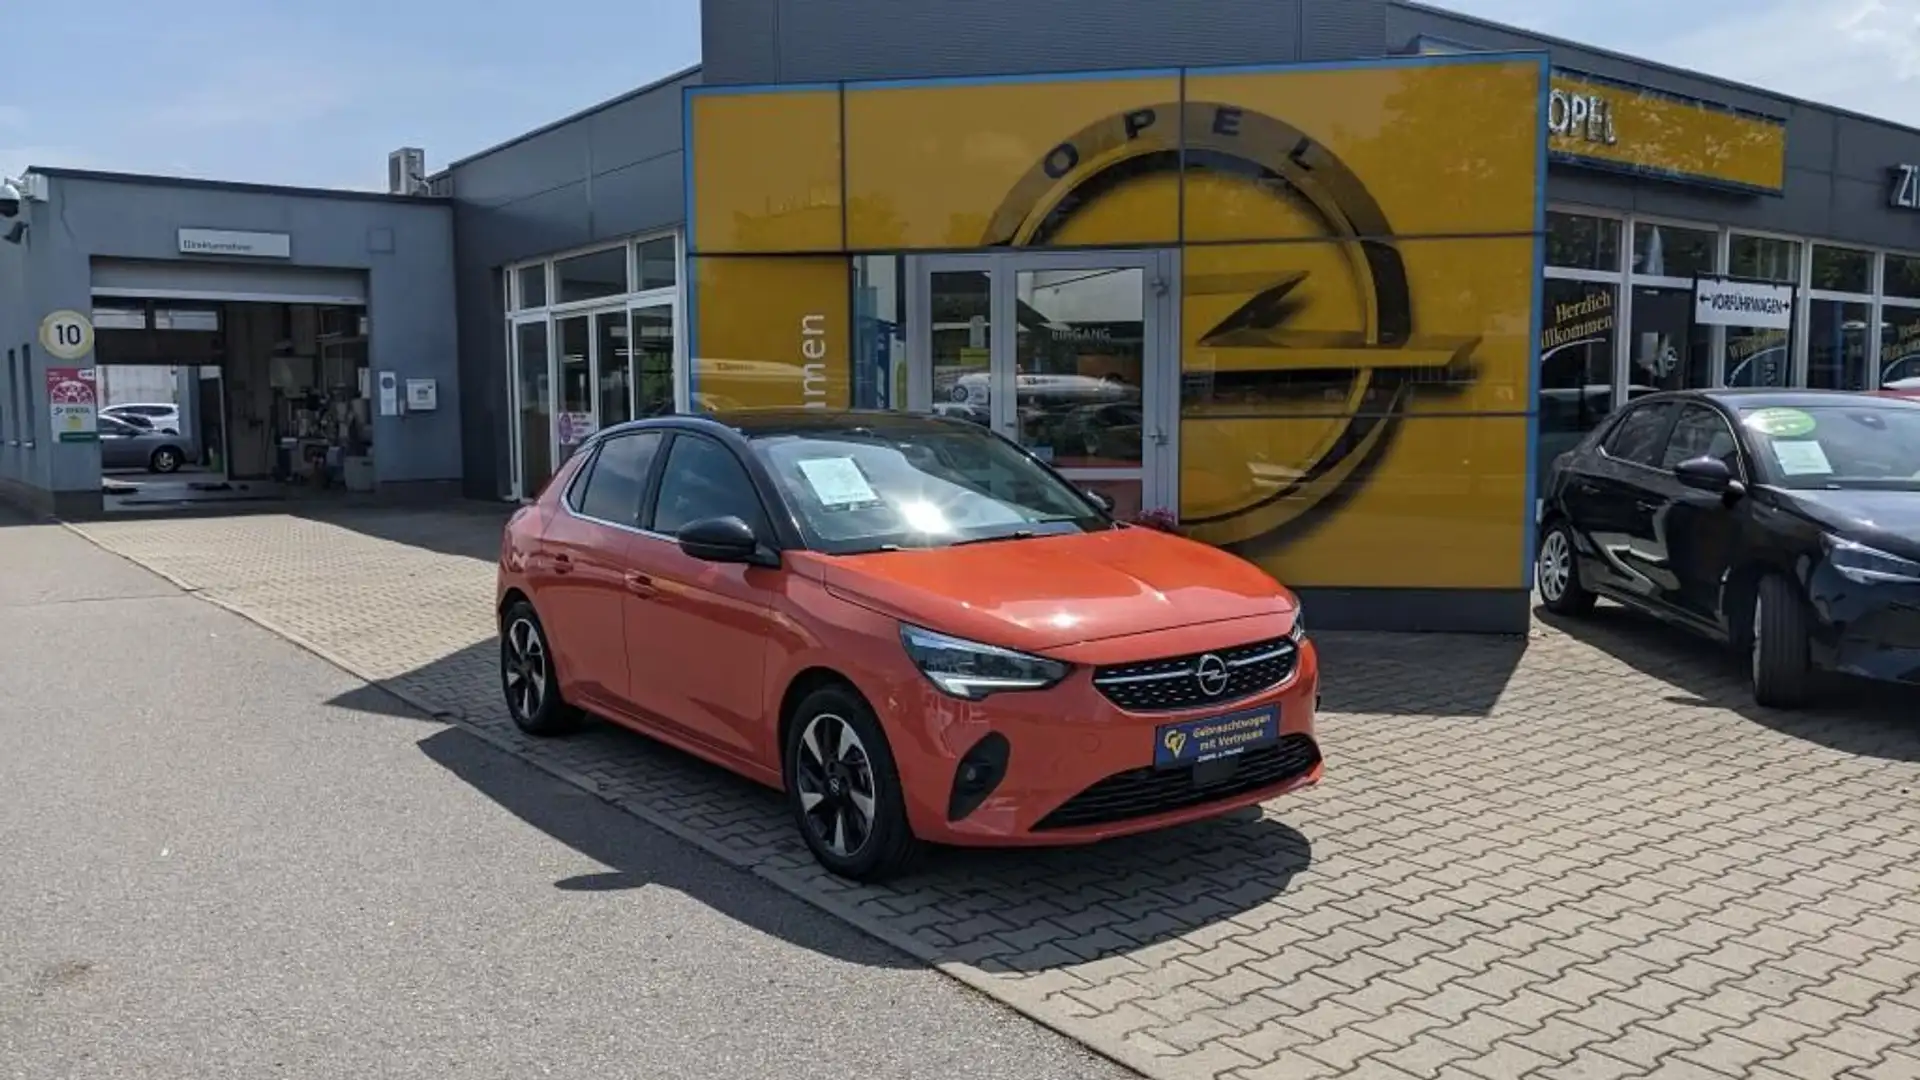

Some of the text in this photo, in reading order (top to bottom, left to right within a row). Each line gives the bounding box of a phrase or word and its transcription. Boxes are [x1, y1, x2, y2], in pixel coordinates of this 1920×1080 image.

[1548, 88, 1616, 143] OPEL
[1043, 107, 1316, 179] OPEL
[1898, 163, 1920, 209] Zi
[1556, 290, 1611, 323] Herzlich
[55, 324, 81, 345] 10
[1052, 328, 1112, 343] EINGANG
[1193, 714, 1271, 738] Gebrauchtwagen
[1200, 729, 1263, 751] mit Vertrauen
